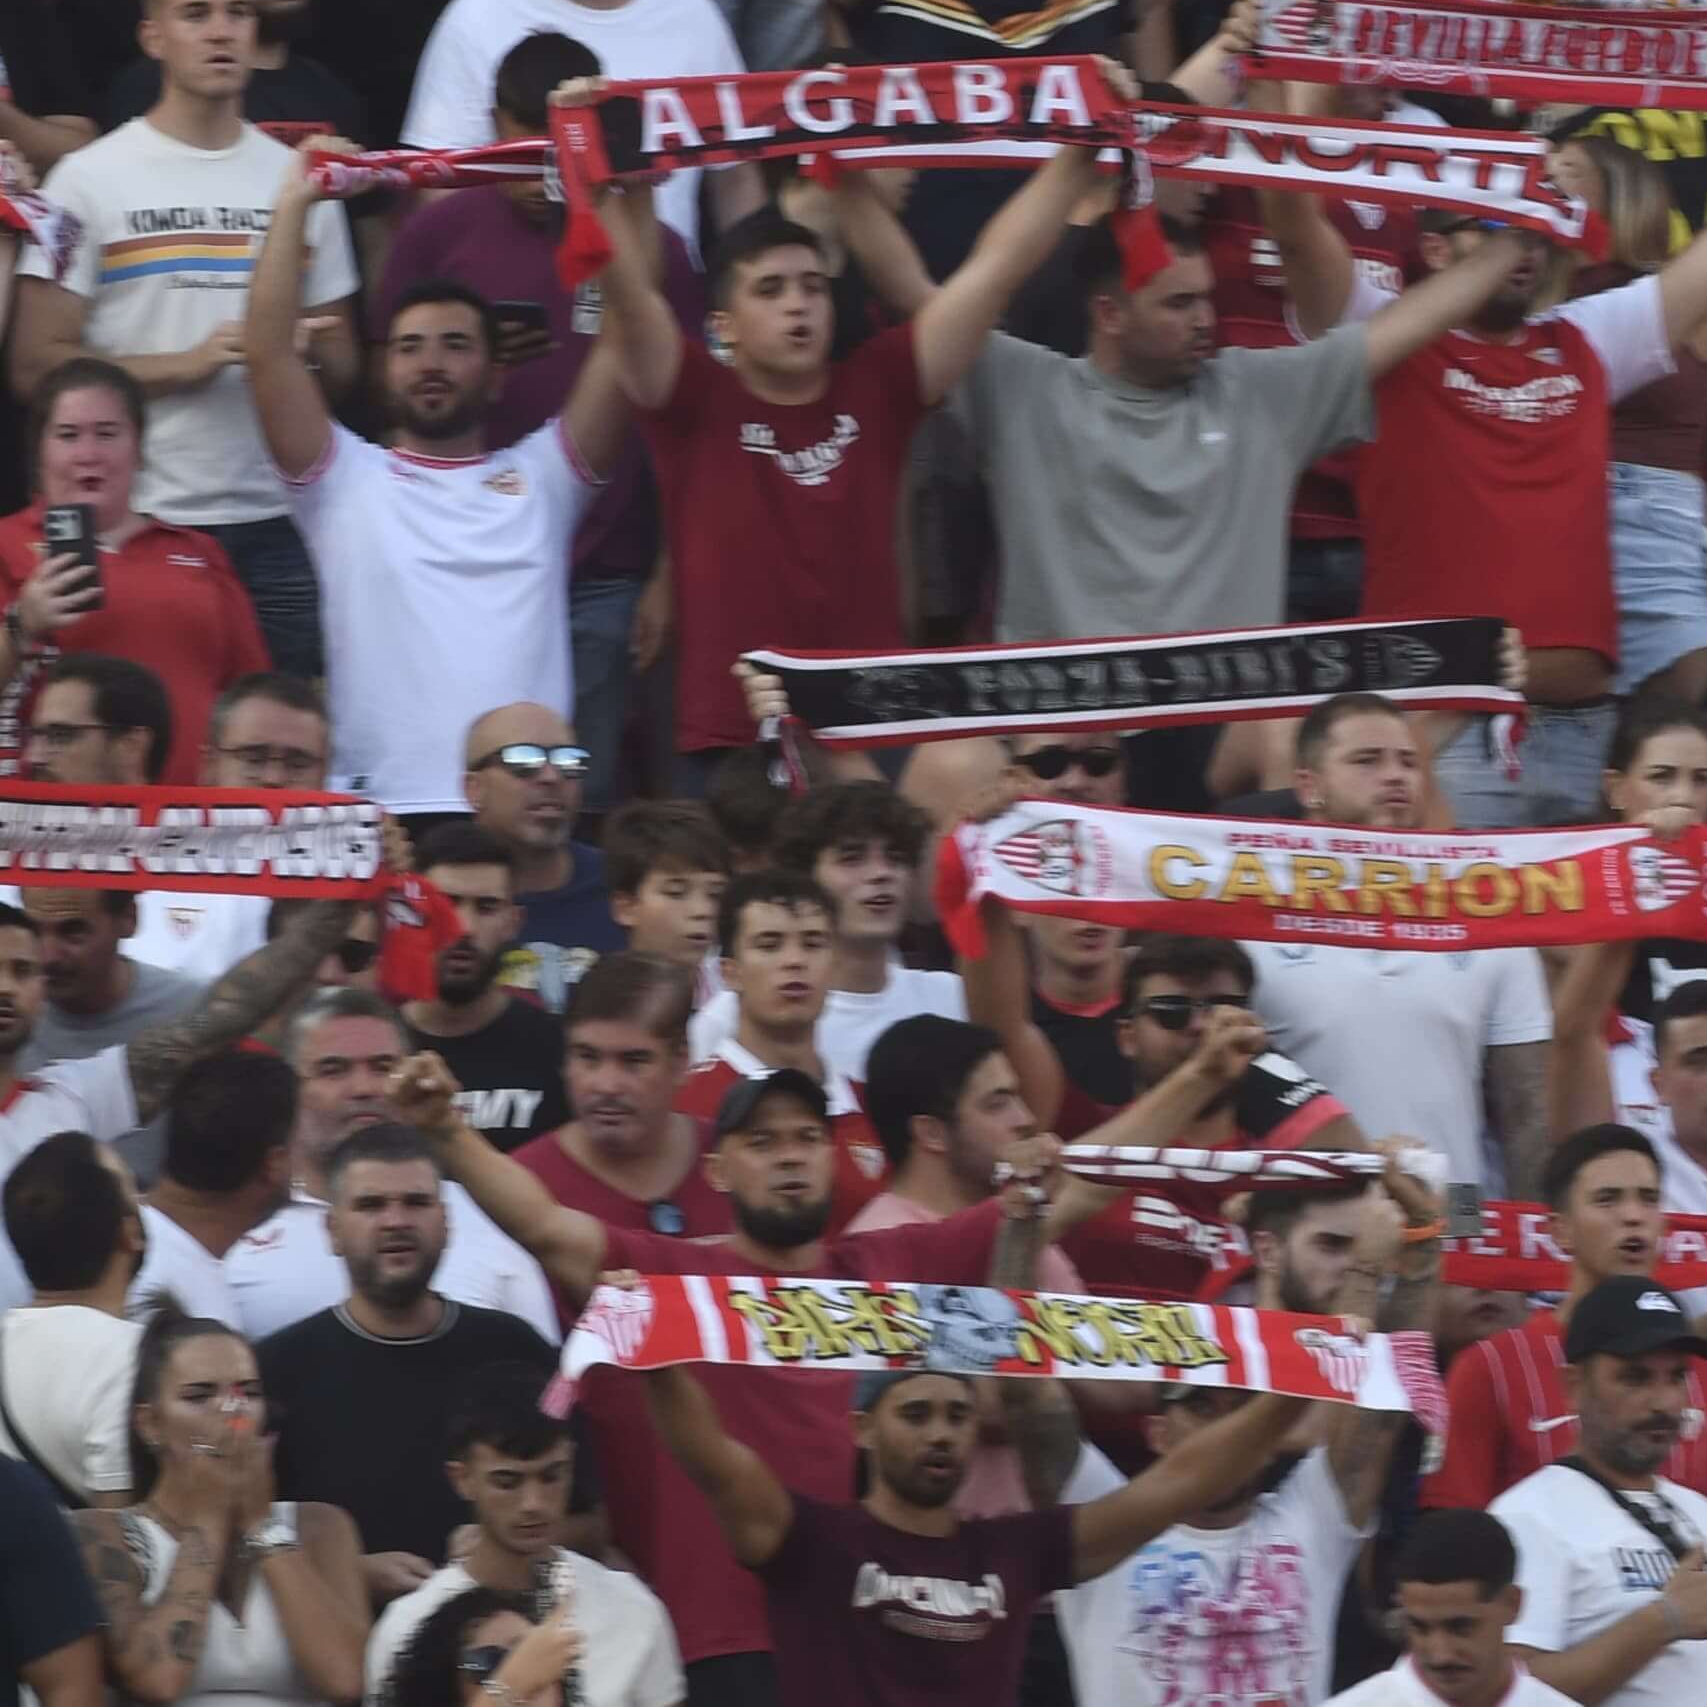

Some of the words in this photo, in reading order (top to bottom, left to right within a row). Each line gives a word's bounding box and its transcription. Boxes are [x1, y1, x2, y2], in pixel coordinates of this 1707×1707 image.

[639, 63, 1095, 153] ALGABA
[1226, 830, 1319, 851] PEÑA
[1148, 844, 1586, 919] CARRION
[1273, 912, 1386, 937] DESDE
